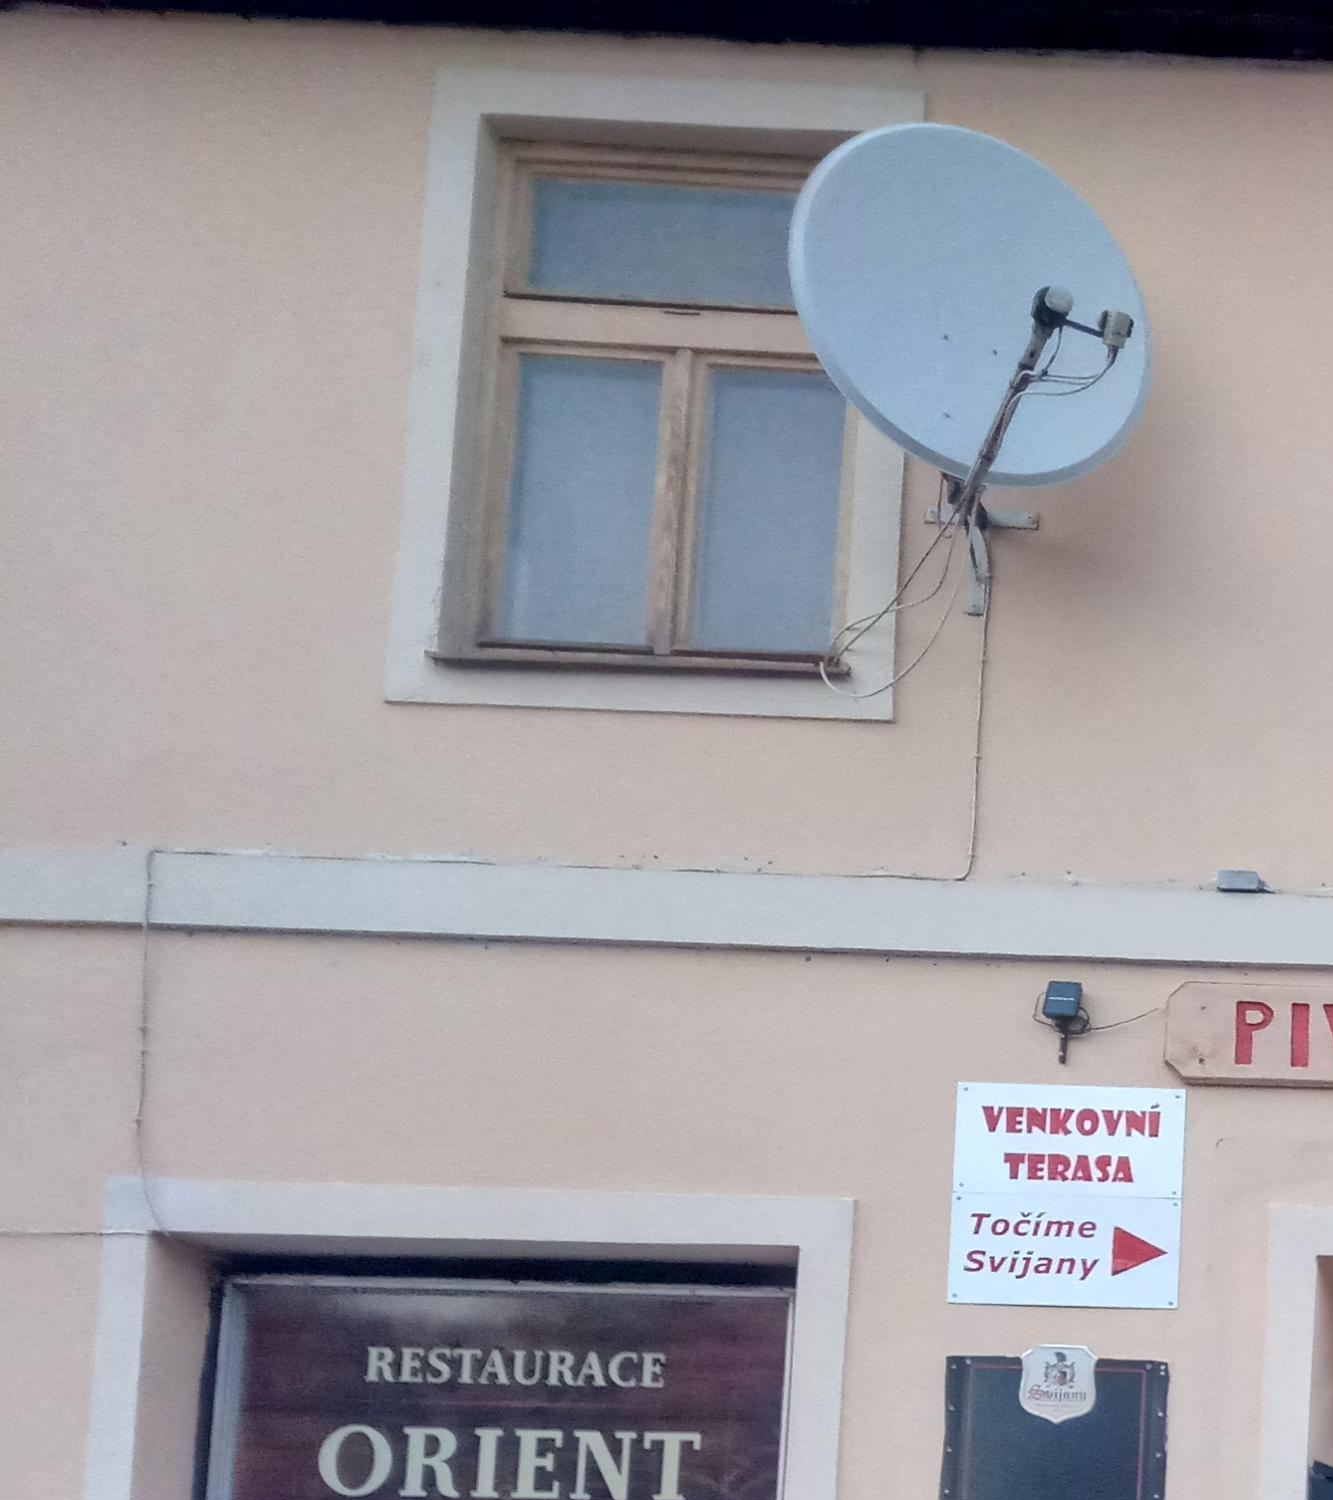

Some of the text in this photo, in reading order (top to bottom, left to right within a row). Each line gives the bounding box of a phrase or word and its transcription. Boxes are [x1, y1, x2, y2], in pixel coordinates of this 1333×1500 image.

[981, 1103, 1162, 1138] VENKOVNÍ
[1003, 1152, 1134, 1183] TERASA
[970, 1211, 1098, 1238] Točíme
[963, 1250, 1100, 1281] Svijany
[364, 1346, 667, 1389] RESTAURACE
